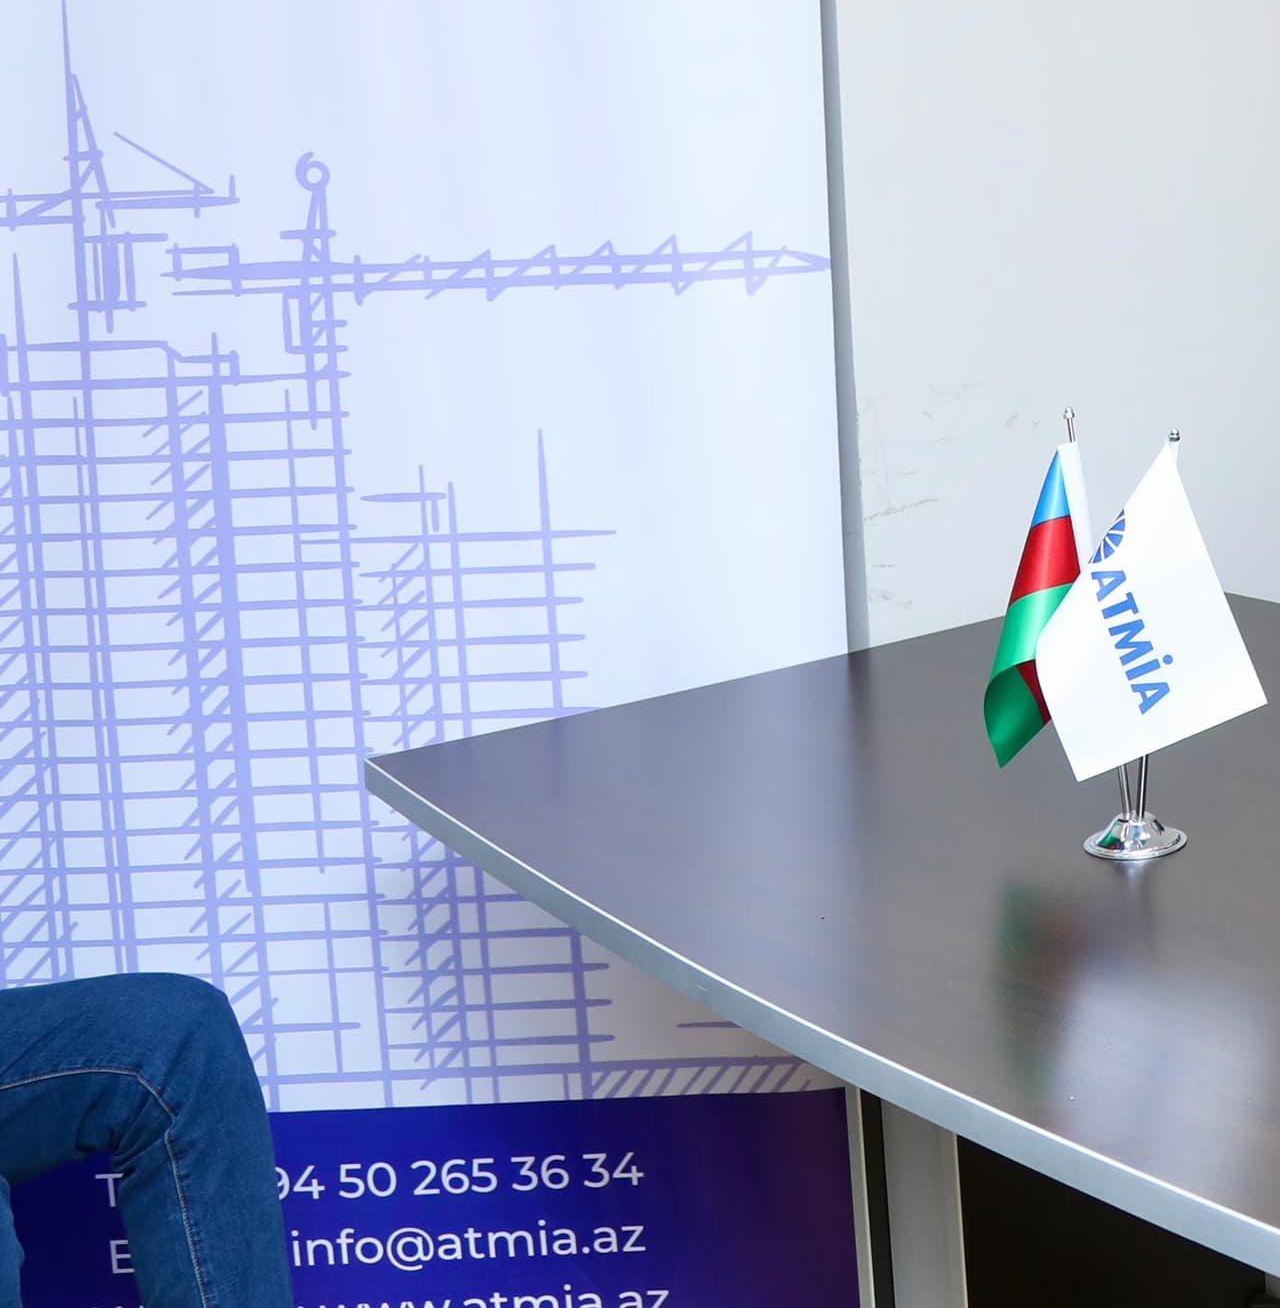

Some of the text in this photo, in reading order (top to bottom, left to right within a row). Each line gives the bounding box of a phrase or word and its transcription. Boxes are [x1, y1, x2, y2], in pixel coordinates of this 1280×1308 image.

[1091, 569, 1174, 715] ATMİA
[274, 1152, 645, 1200] 94 50 265 36 34
[291, 1219, 647, 1271] info@atmia.az
